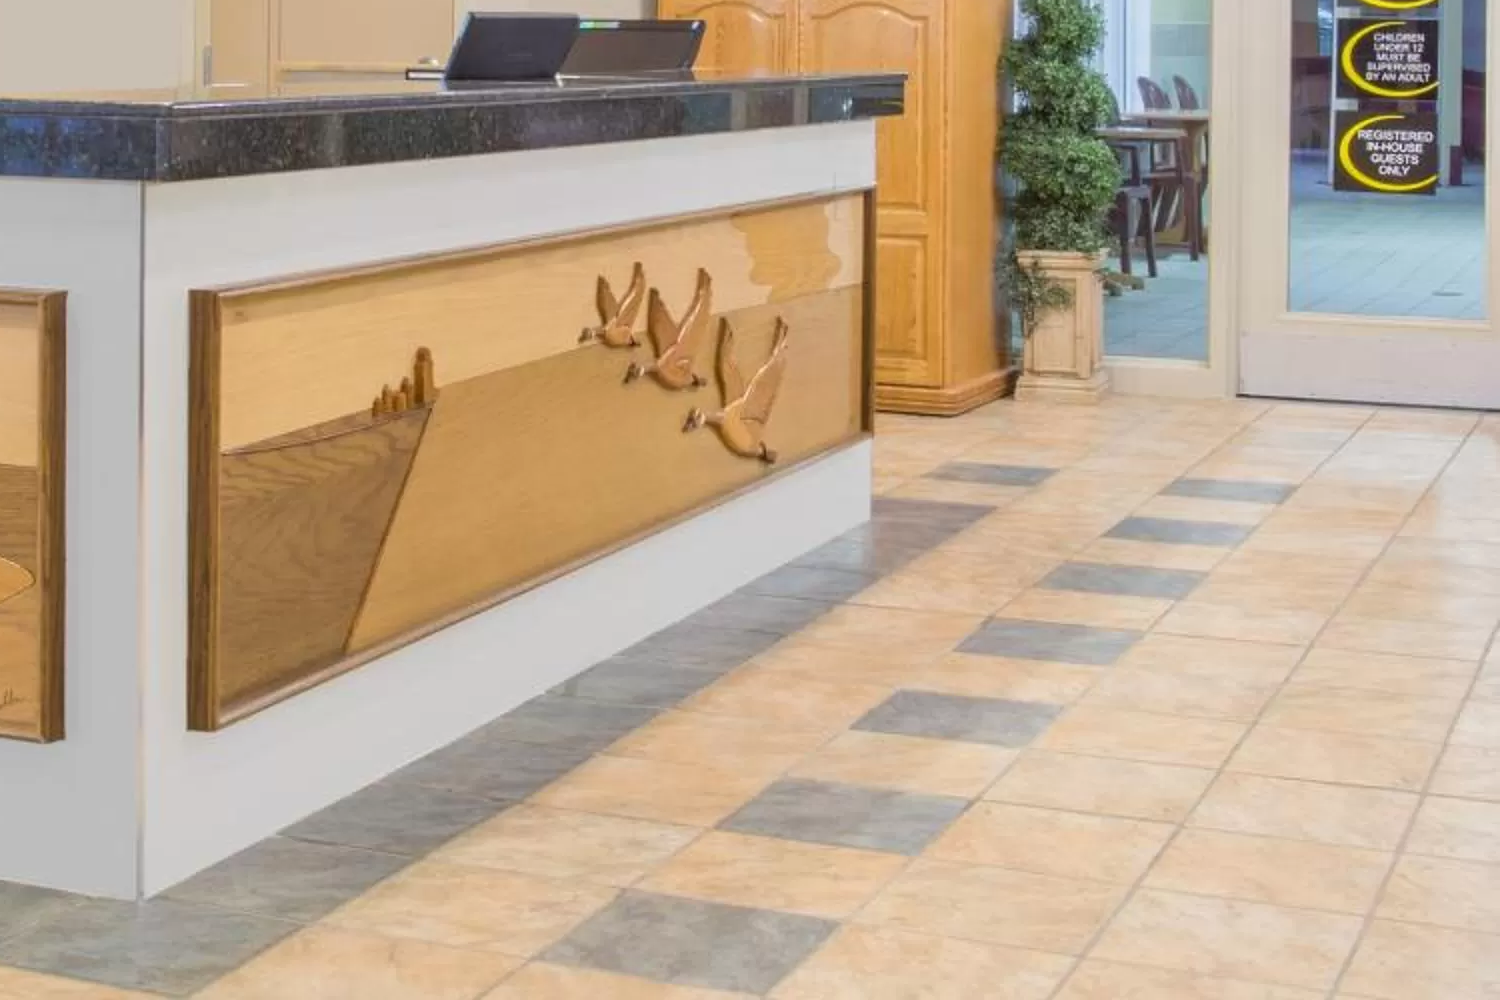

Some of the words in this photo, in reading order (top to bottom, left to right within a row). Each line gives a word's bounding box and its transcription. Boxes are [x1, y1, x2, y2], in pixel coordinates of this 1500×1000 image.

[1398, 72, 1431, 83] ADULT
[1358, 130, 1434, 142] REGISTERED
[1366, 141, 1423, 153] IN-HOUSE
[1370, 153, 1420, 165] GUESTS
[1378, 165, 1411, 177] ONLY
